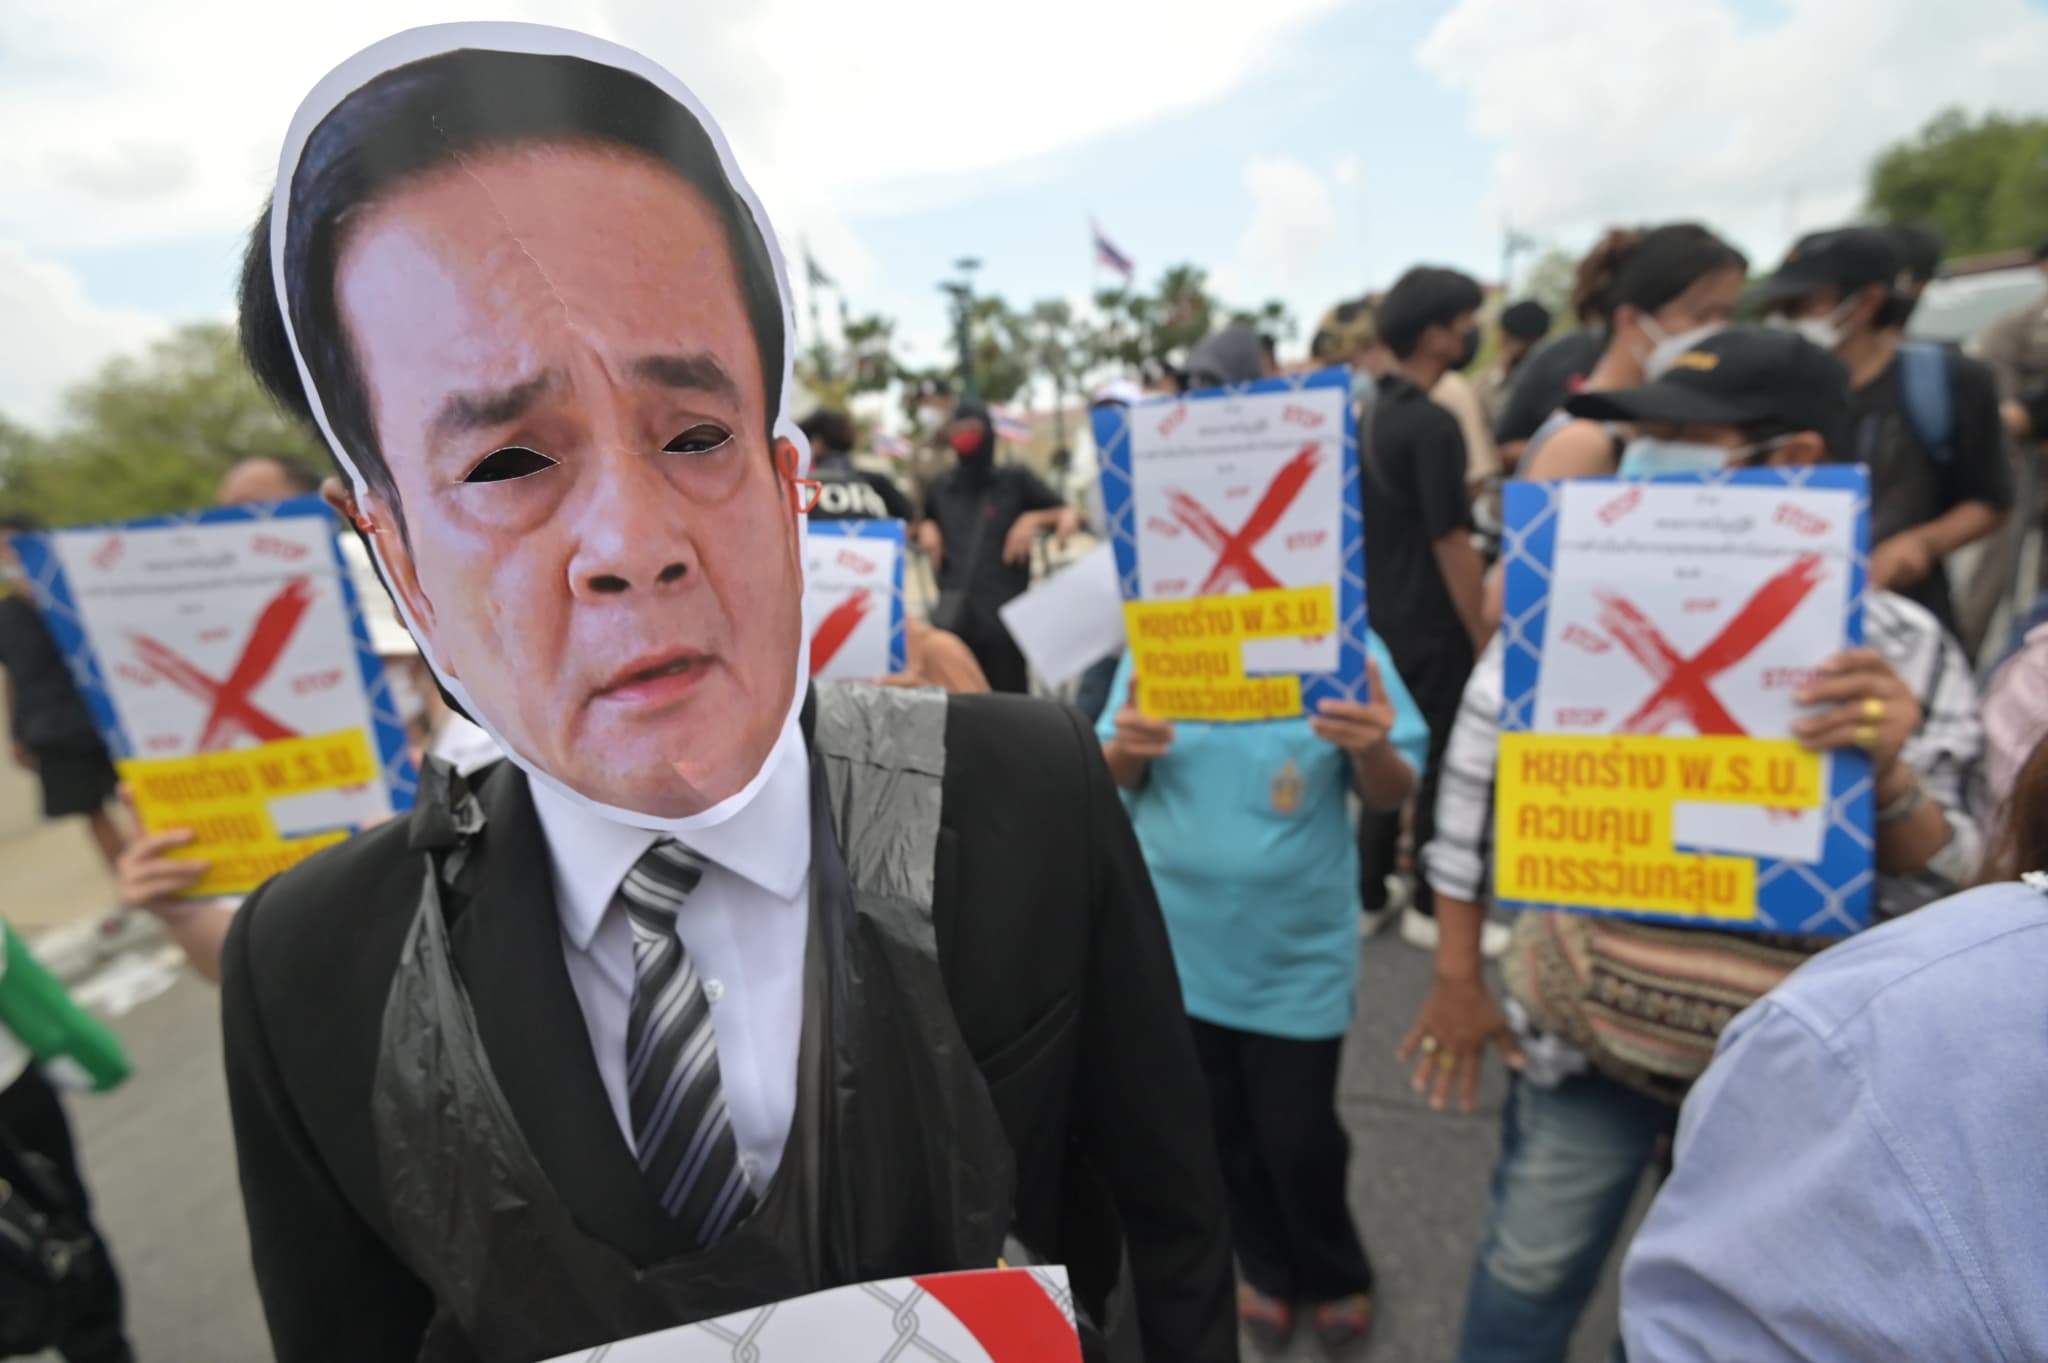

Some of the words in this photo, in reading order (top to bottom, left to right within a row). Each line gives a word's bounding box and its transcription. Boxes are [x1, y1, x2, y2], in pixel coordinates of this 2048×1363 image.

[1282, 404, 1327, 429] STOP
[1772, 501, 1831, 537] STOP
[1284, 530, 1328, 550] STOP
[1554, 708, 1607, 727] STOP
[1519, 738, 1667, 797] หยุดร่าง
[1676, 752, 1811, 798] พ.ร.บ.
[1516, 803, 1653, 855] ควบคุม
[1515, 854, 1738, 916] การรวมกลุ่ม
